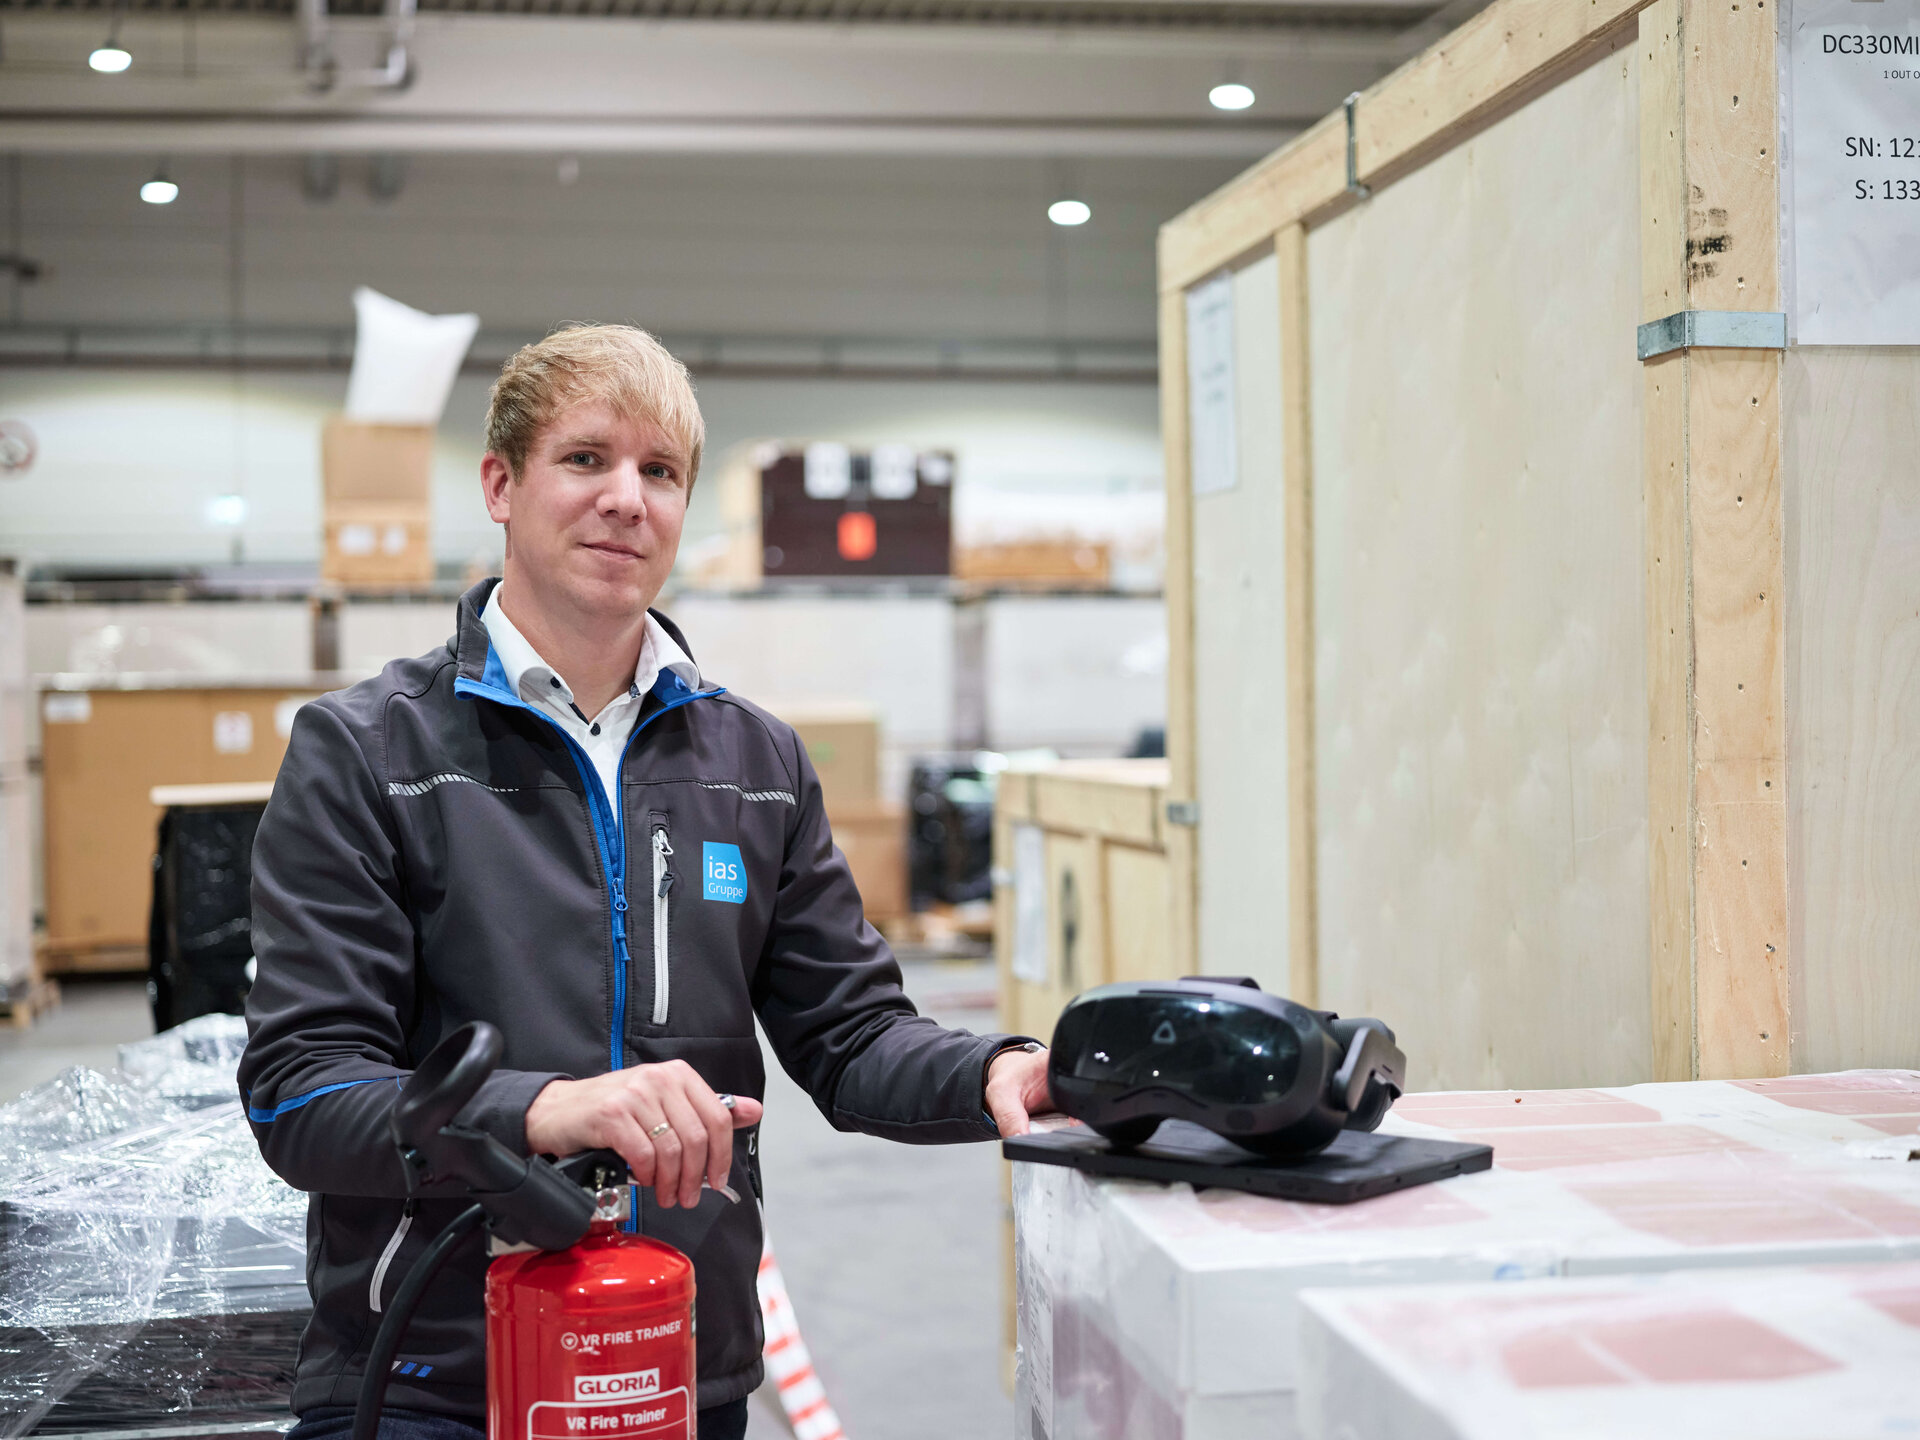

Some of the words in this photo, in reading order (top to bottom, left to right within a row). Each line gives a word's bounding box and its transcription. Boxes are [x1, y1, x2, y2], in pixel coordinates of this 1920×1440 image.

[1883, 70, 1889, 79] 1
[1891, 70, 1911, 79] OUT
[1845, 136, 1881, 157] SN:
[1889, 137, 1920, 158] 12
[1855, 179, 1873, 200] S:
[1883, 179, 1920, 200] 133
[708, 855, 738, 881] ias
[708, 882, 744, 899] Gruppe
[580, 1333, 600, 1346] VR
[603, 1330, 633, 1346] FIRE
[635, 1319, 682, 1341] TRAINER
[578, 1373, 657, 1395] GLORIA
[566, 1415, 587, 1430] VR
[590, 1414, 619, 1430] Fire
[621, 1407, 667, 1427] Trainer
